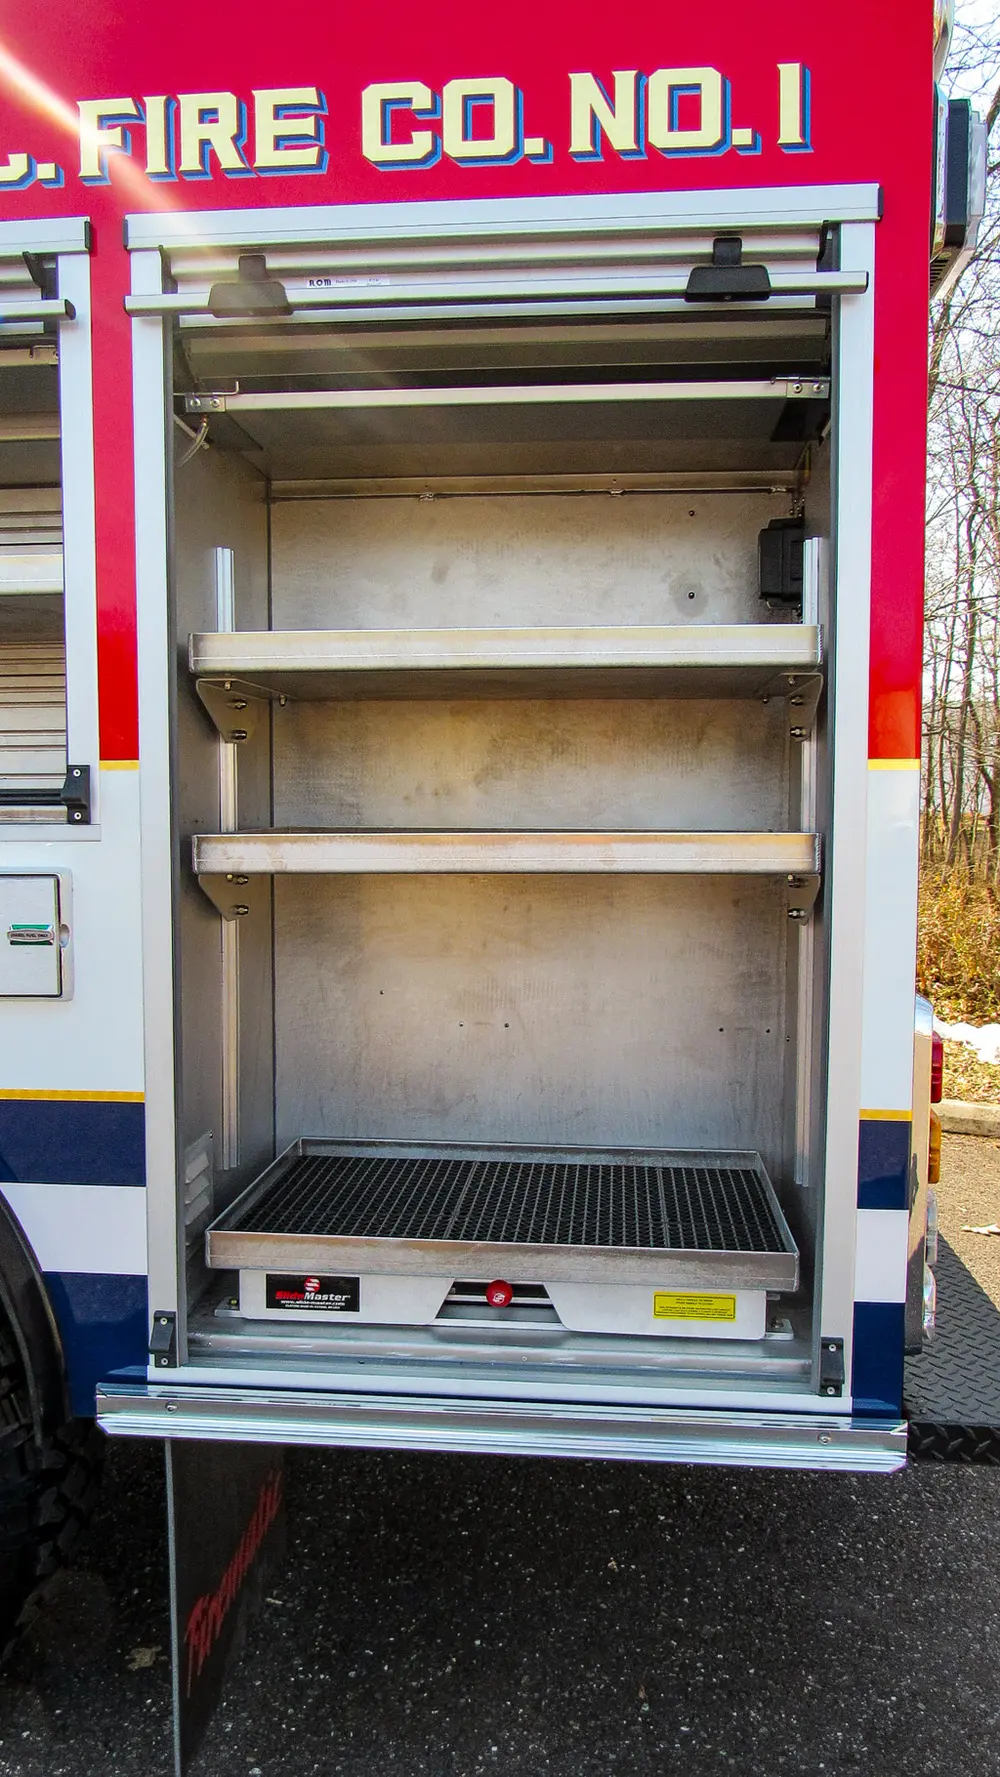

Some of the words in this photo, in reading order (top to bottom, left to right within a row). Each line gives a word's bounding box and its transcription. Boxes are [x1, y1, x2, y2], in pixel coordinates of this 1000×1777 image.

[77, 86, 329, 186] FIRE
[361, 77, 553, 171] CO.
[568, 66, 762, 163] NO.
[309, 278, 332, 287] ROM
